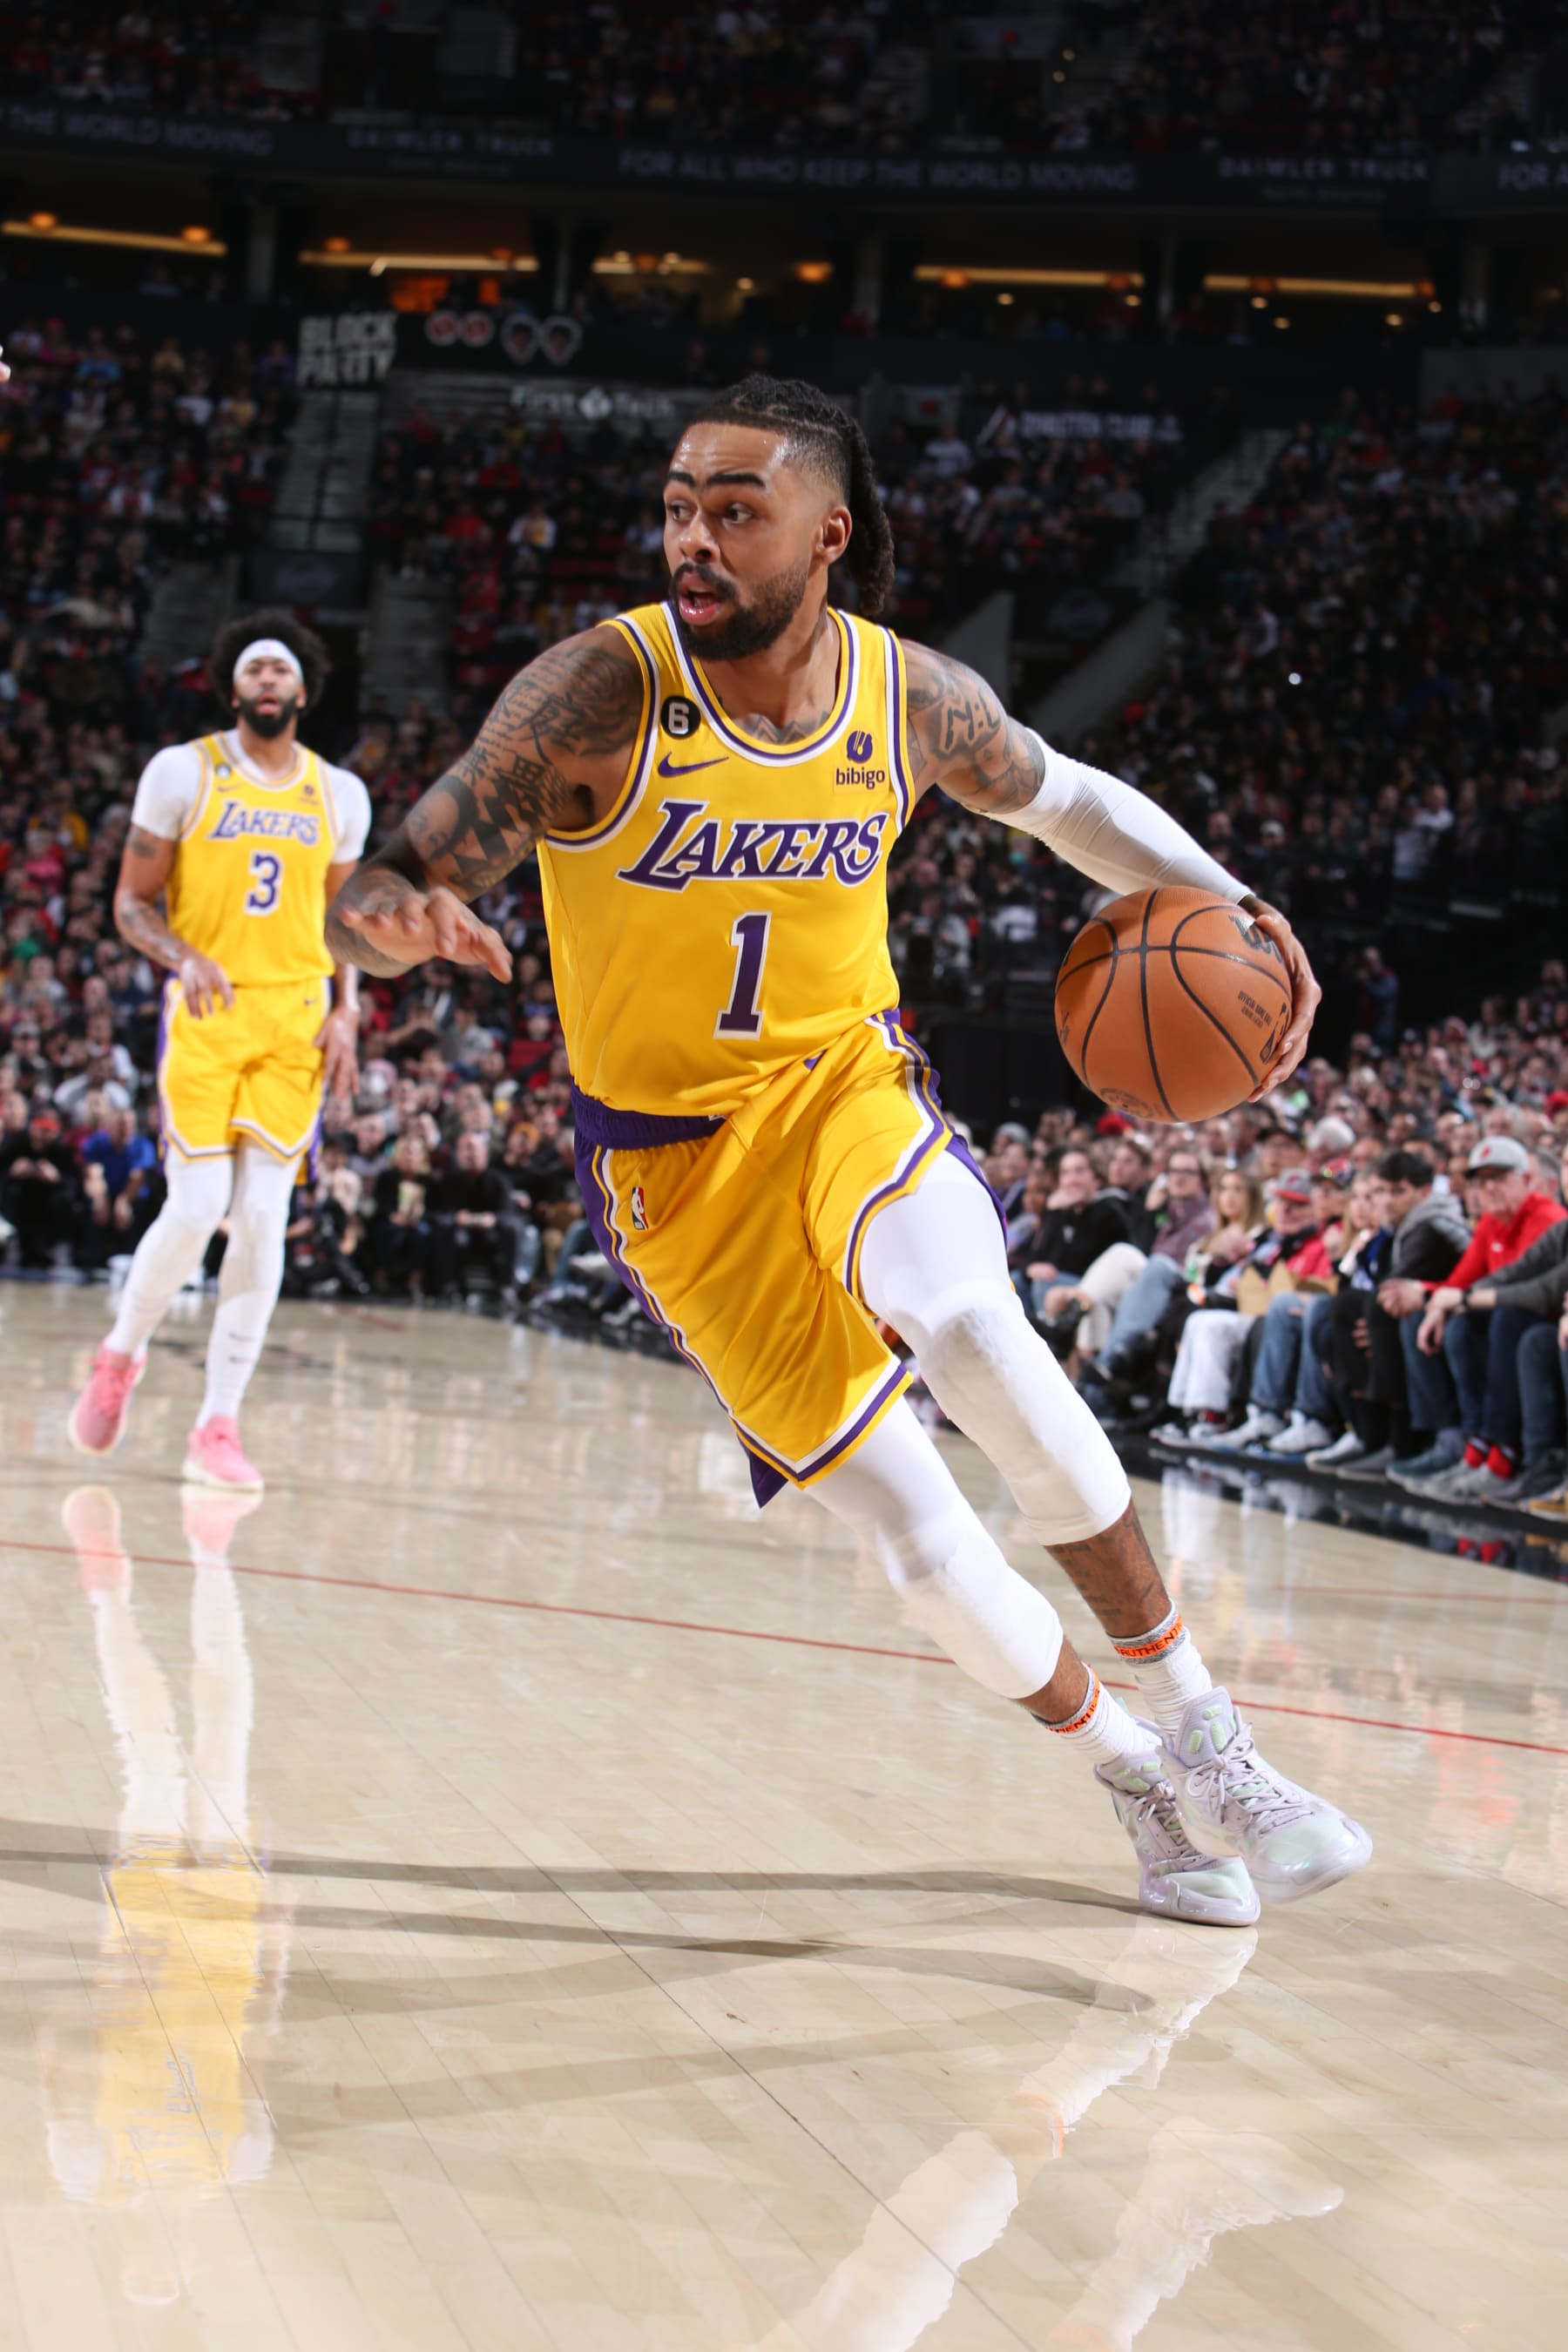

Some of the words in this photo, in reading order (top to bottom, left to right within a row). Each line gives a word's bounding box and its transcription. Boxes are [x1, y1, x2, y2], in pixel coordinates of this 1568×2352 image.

[8, 105, 57, 136] THE
[63, 113, 160, 146] WORLD
[166, 121, 274, 157] MOVING
[474, 132, 556, 158] TRUCK
[618, 148, 673, 178] FOR
[679, 152, 725, 180] ALL
[733, 154, 797, 185] WHO
[803, 157, 869, 186] KEEP
[875, 159, 920, 187] THE
[928, 160, 1024, 190] WORLD
[1029, 162, 1136, 191] MOVING
[1220, 156, 1335, 179] DAIMLER
[1349, 159, 1428, 181] TRUCK
[1498, 162, 1550, 190] FOR
[298, 310, 398, 348] BLOCK
[295, 348, 395, 387] PARTY
[667, 702, 691, 735] 6
[835, 767, 886, 790] bibigo
[206, 801, 320, 846] LAKERS
[615, 797, 890, 894] LAKERS
[245, 848, 284, 918] 3
[713, 910, 773, 1041] 1
